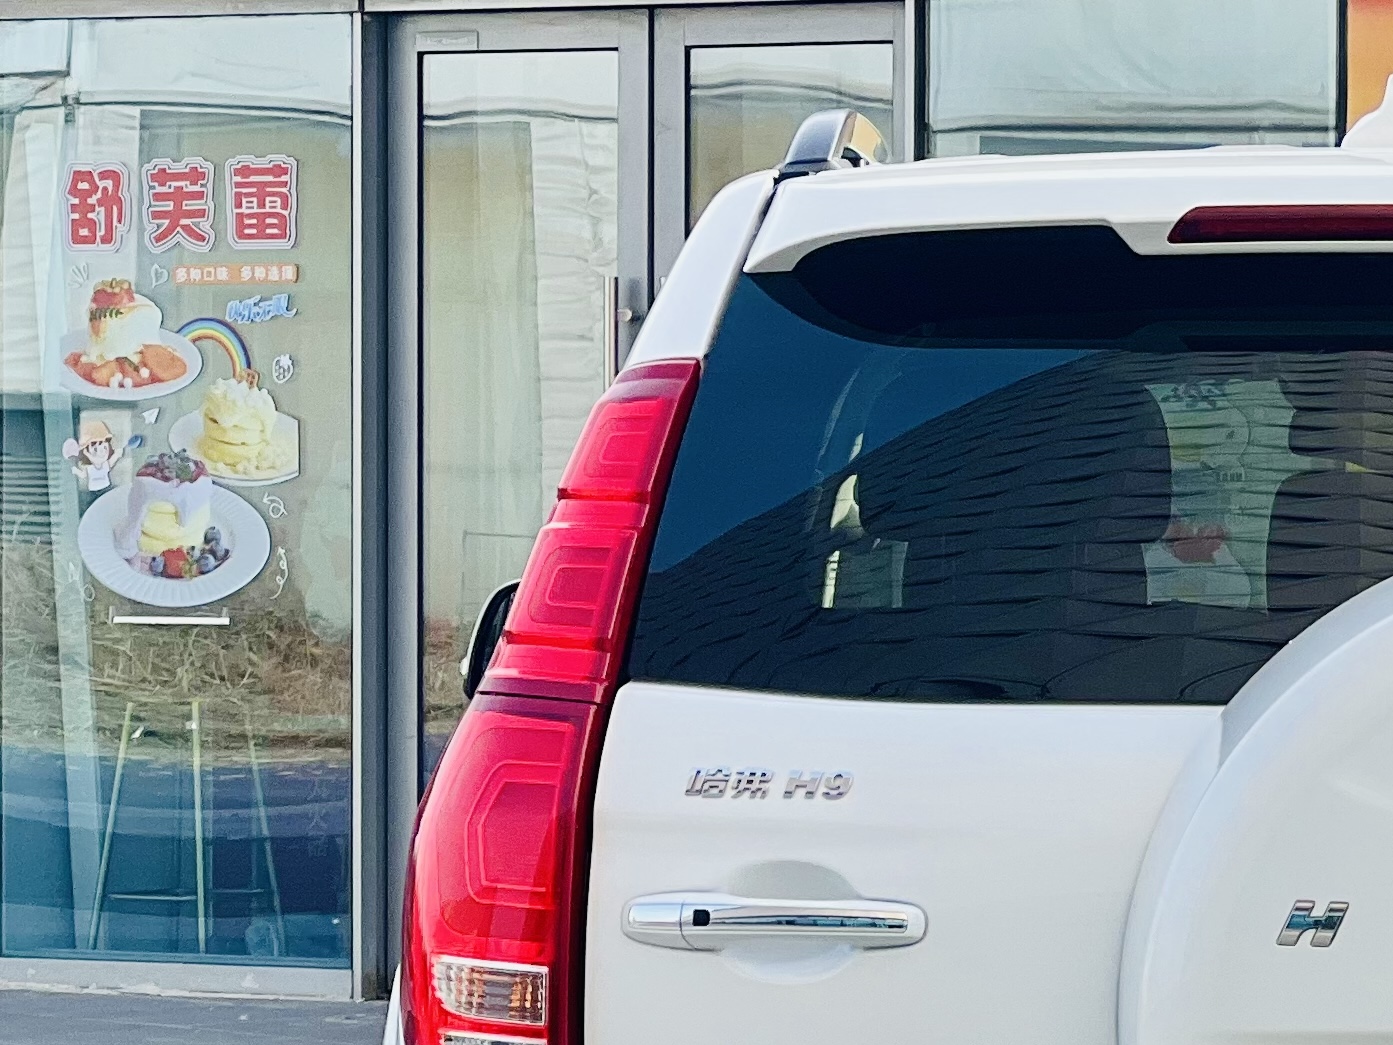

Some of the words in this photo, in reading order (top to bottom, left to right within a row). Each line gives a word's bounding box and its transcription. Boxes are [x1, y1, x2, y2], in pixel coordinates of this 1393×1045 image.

[66, 161, 292, 248] 舒芙蕾
[175, 266, 229, 282] 多种口味
[685, 766, 774, 800] 哈弗
[783, 768, 853, 801] H9
